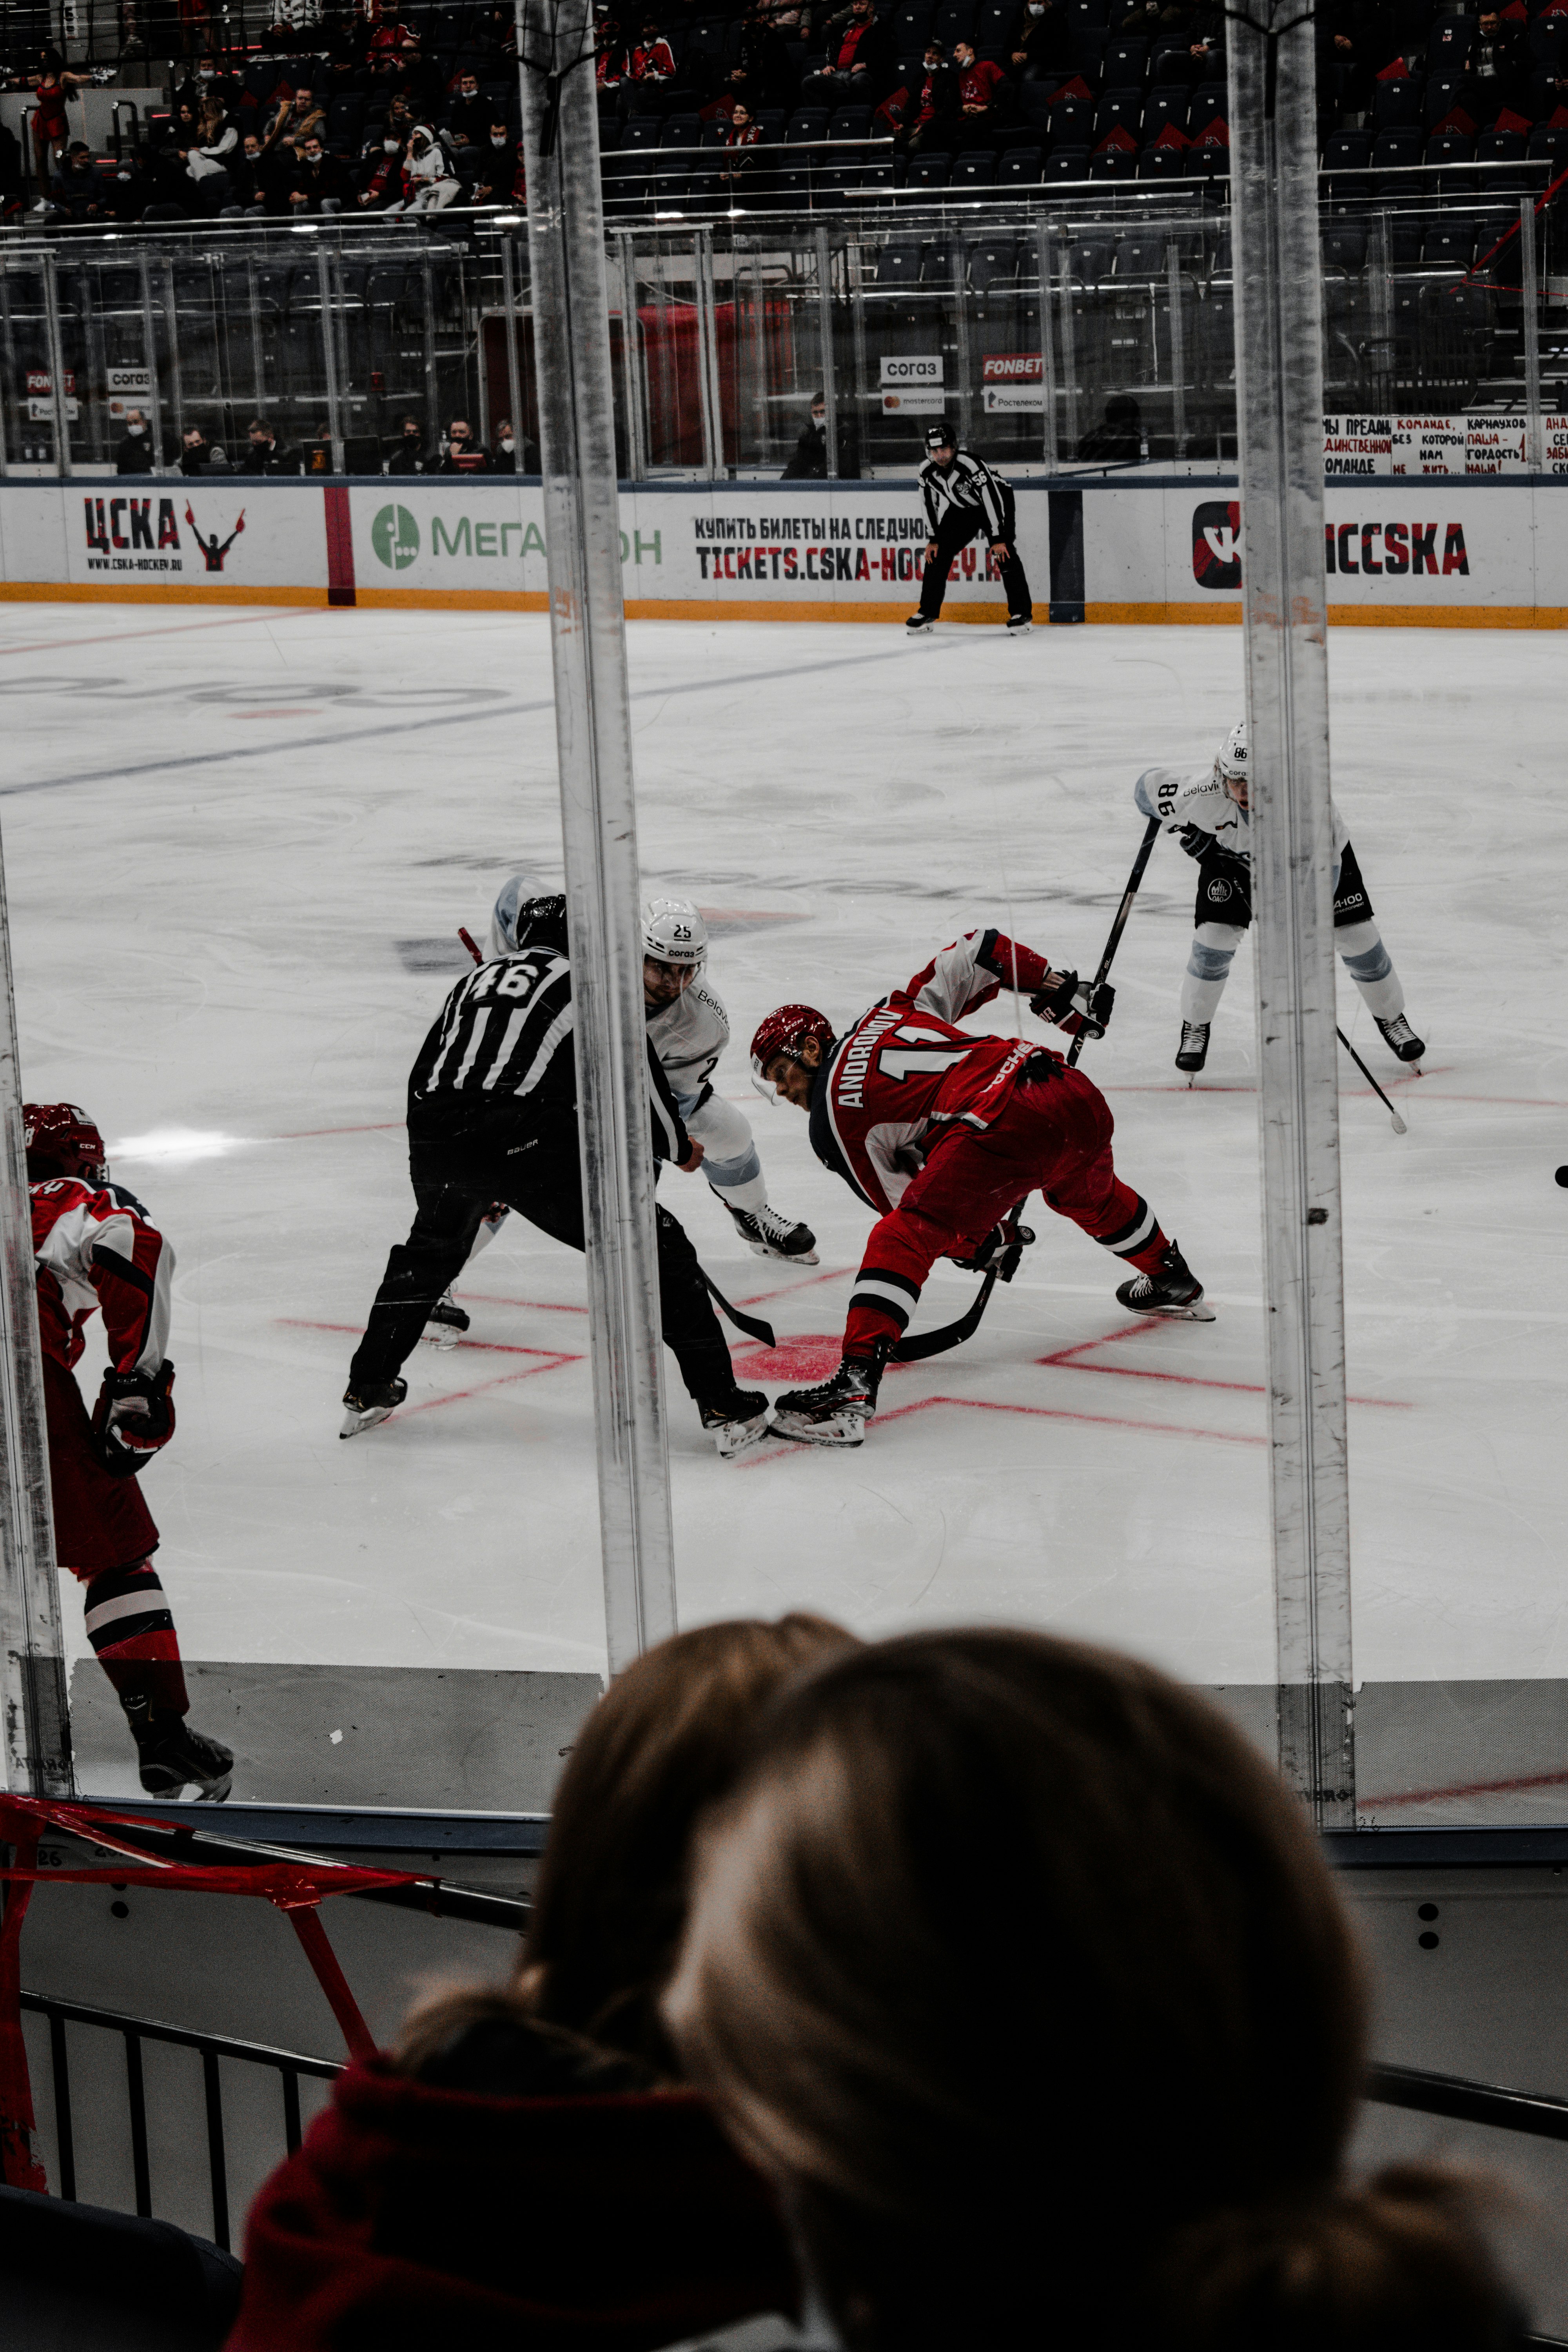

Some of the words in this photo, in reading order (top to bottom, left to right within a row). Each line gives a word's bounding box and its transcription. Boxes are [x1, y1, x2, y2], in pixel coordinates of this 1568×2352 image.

[887, 363, 937, 376] согаз
[984, 358, 1044, 375] FONBET
[28, 375, 74, 388] FONT
[1397, 419, 1455, 431] КОМАНДЕ,
[1467, 418, 1526, 430] КАРНАУХОВ
[1546, 417, 1568, 430] АНД
[1323, 437, 1391, 454] ДИНСТВЕННОЙ
[1392, 434, 1412, 445] БЕЗ
[1422, 432, 1464, 445] КОТОРОЙ
[1419, 450, 1443, 460] НАМ
[1467, 448, 1520, 460] ГОРДОСТЬ
[1324, 458, 1376, 474] ОМАНДЕ
[1393, 464, 1406, 474] НЕ
[1467, 459, 1502, 474] НАША!
[971, 471, 987, 486] 56
[83, 497, 181, 555] ЦСКА
[695, 517, 757, 540] КУПИТЬ
[760, 517, 826, 540] БИЛЕТЫ
[830, 518, 851, 540] НА
[855, 518, 928, 542] СЛЕДУЮ
[431, 516, 662, 565] МЕГАН
[1234, 747, 1248, 759] 86
[1158, 783, 1179, 817] 86
[673, 924, 691, 938] 25
[668, 949, 695, 958] согаз
[469, 964, 539, 1000] 46
[838, 1009, 904, 1109] ANDRONOV
[877, 1024, 973, 1083] 11
[697, 1057, 719, 1083] 2
[25, 1127, 35, 1147] 8
